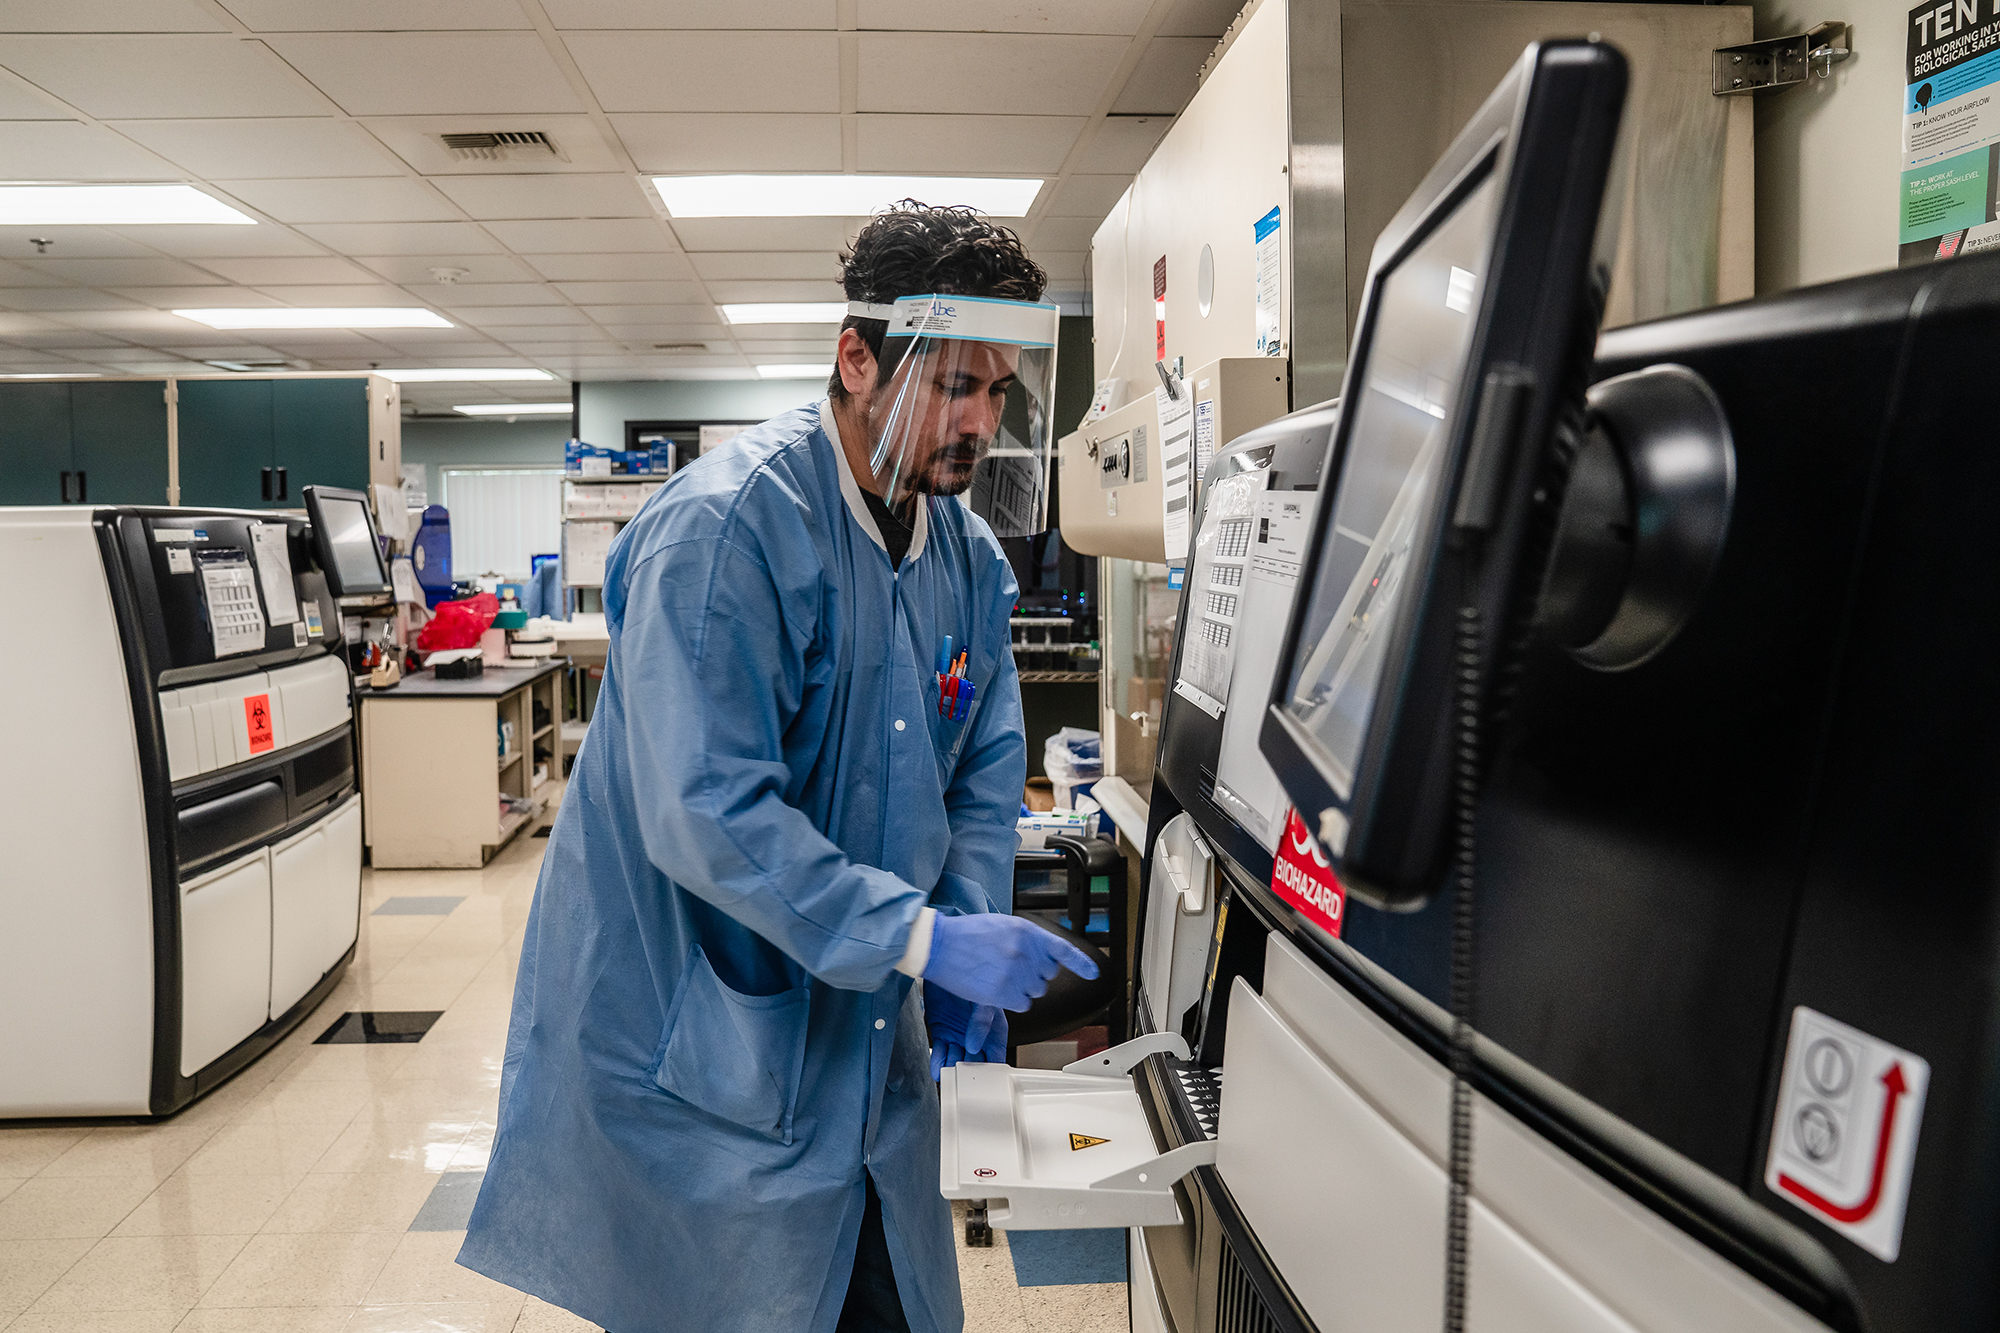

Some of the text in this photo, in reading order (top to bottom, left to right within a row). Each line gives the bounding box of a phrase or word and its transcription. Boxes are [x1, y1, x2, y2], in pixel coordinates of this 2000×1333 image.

[1915, 0, 1978, 47] TEN
[1914, 20, 2000, 66] FOR WORKING IN Y
[1914, 45, 1970, 77] BIOLOGICAL
[1912, 121, 1922, 130] TIP
[1928, 112, 1946, 124] KNOW
[1947, 106, 1963, 118] YOUR
[1963, 96, 1991, 112] AIRFLOW
[1910, 180, 1920, 189] TIP
[1928, 173, 1946, 184] WORK
[1946, 170, 1954, 180] AT
[1910, 170, 1979, 196] THE PROPER SASH LEVEL
[1983, 232, 2000, 243] NEVE
[1274, 855, 1342, 921] BIOHAZARD
